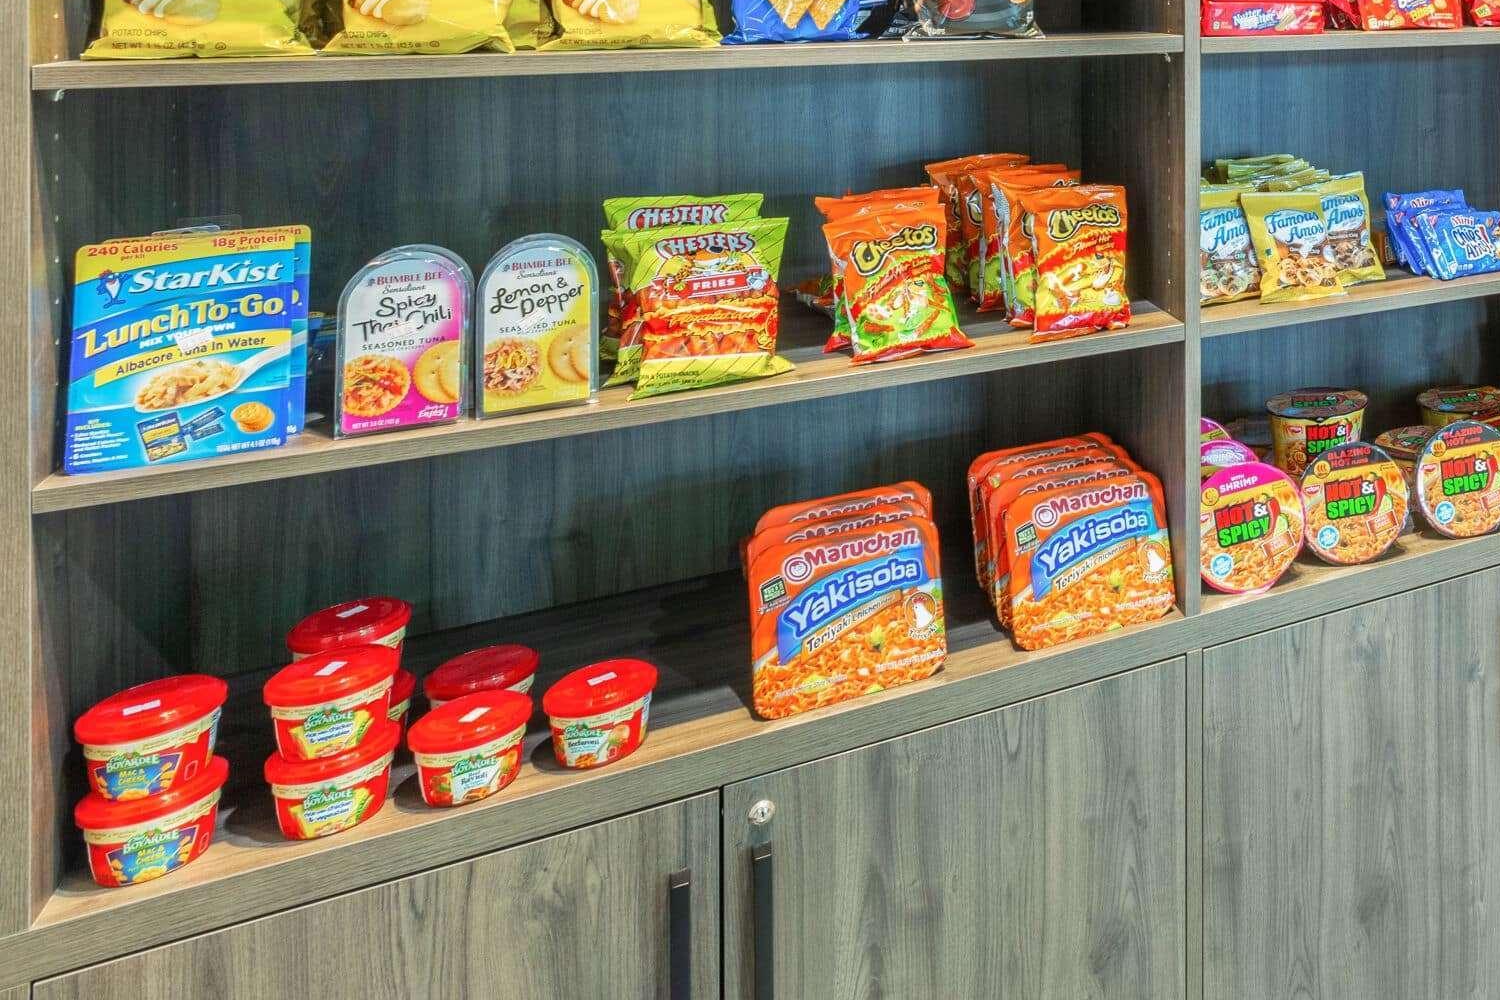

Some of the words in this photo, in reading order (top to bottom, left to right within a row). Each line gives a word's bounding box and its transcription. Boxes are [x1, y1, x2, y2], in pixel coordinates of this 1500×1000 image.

[1050, 205, 1119, 239] Cheetos
[1265, 208, 1319, 234] Famous
[1326, 207, 1365, 230] Amos
[1450, 215, 1475, 226] Mini
[87, 246, 119, 257] 240
[123, 242, 178, 255] Calories
[213, 236, 236, 249] 18g
[240, 233, 286, 246] Protein
[1285, 223, 1324, 243] Amos
[1453, 227, 1481, 247] Chips
[854, 226, 935, 272] Cheetos
[1465, 232, 1495, 260] Ahoy!
[127, 260, 284, 294] StarKist
[511, 259, 553, 271] BUMBLE
[555, 258, 573, 267] BEE
[376, 273, 421, 286] BUMBLE
[424, 271, 445, 282] BEE
[692, 278, 737, 291] FRIES
[375, 293, 437, 318] Spicy
[489, 281, 553, 314] Lemon
[557, 276, 568, 289] &
[520, 284, 585, 317] Pepper
[76, 303, 190, 358] Lunch
[188, 294, 285, 326] To-Go
[404, 305, 452, 330] Chili
[550, 319, 577, 328] TUNA
[139, 336, 164, 349] MIX
[361, 338, 415, 351] SEASONED
[419, 335, 446, 345] TUNA
[116, 352, 173, 376] Albacore
[227, 336, 266, 348] Water
[1306, 425, 1337, 440] HOT
[1336, 425, 1346, 436] &
[1446, 438, 1465, 447] HOT
[1327, 447, 1371, 460] BLAZING
[1331, 458, 1351, 467] HOT
[1441, 456, 1475, 477] HOT
[1474, 459, 1487, 471] &
[1219, 475, 1258, 493] SHRIMP
[1324, 479, 1362, 501] HOT
[1361, 481, 1375, 494] &
[1443, 472, 1489, 497] SPICY
[1049, 483, 1145, 515] Maruchan
[1327, 494, 1376, 520] SPICY
[1216, 503, 1255, 528] HOT
[1254, 503, 1268, 517] &
[1040, 509, 1149, 571] Yakisoba
[1218, 517, 1270, 547] SPICY
[804, 528, 917, 567] Maruchan
[1056, 560, 1093, 590] Teriyaki
[788, 559, 918, 633] Yakisoba
[806, 614, 851, 652] Teriyaki
